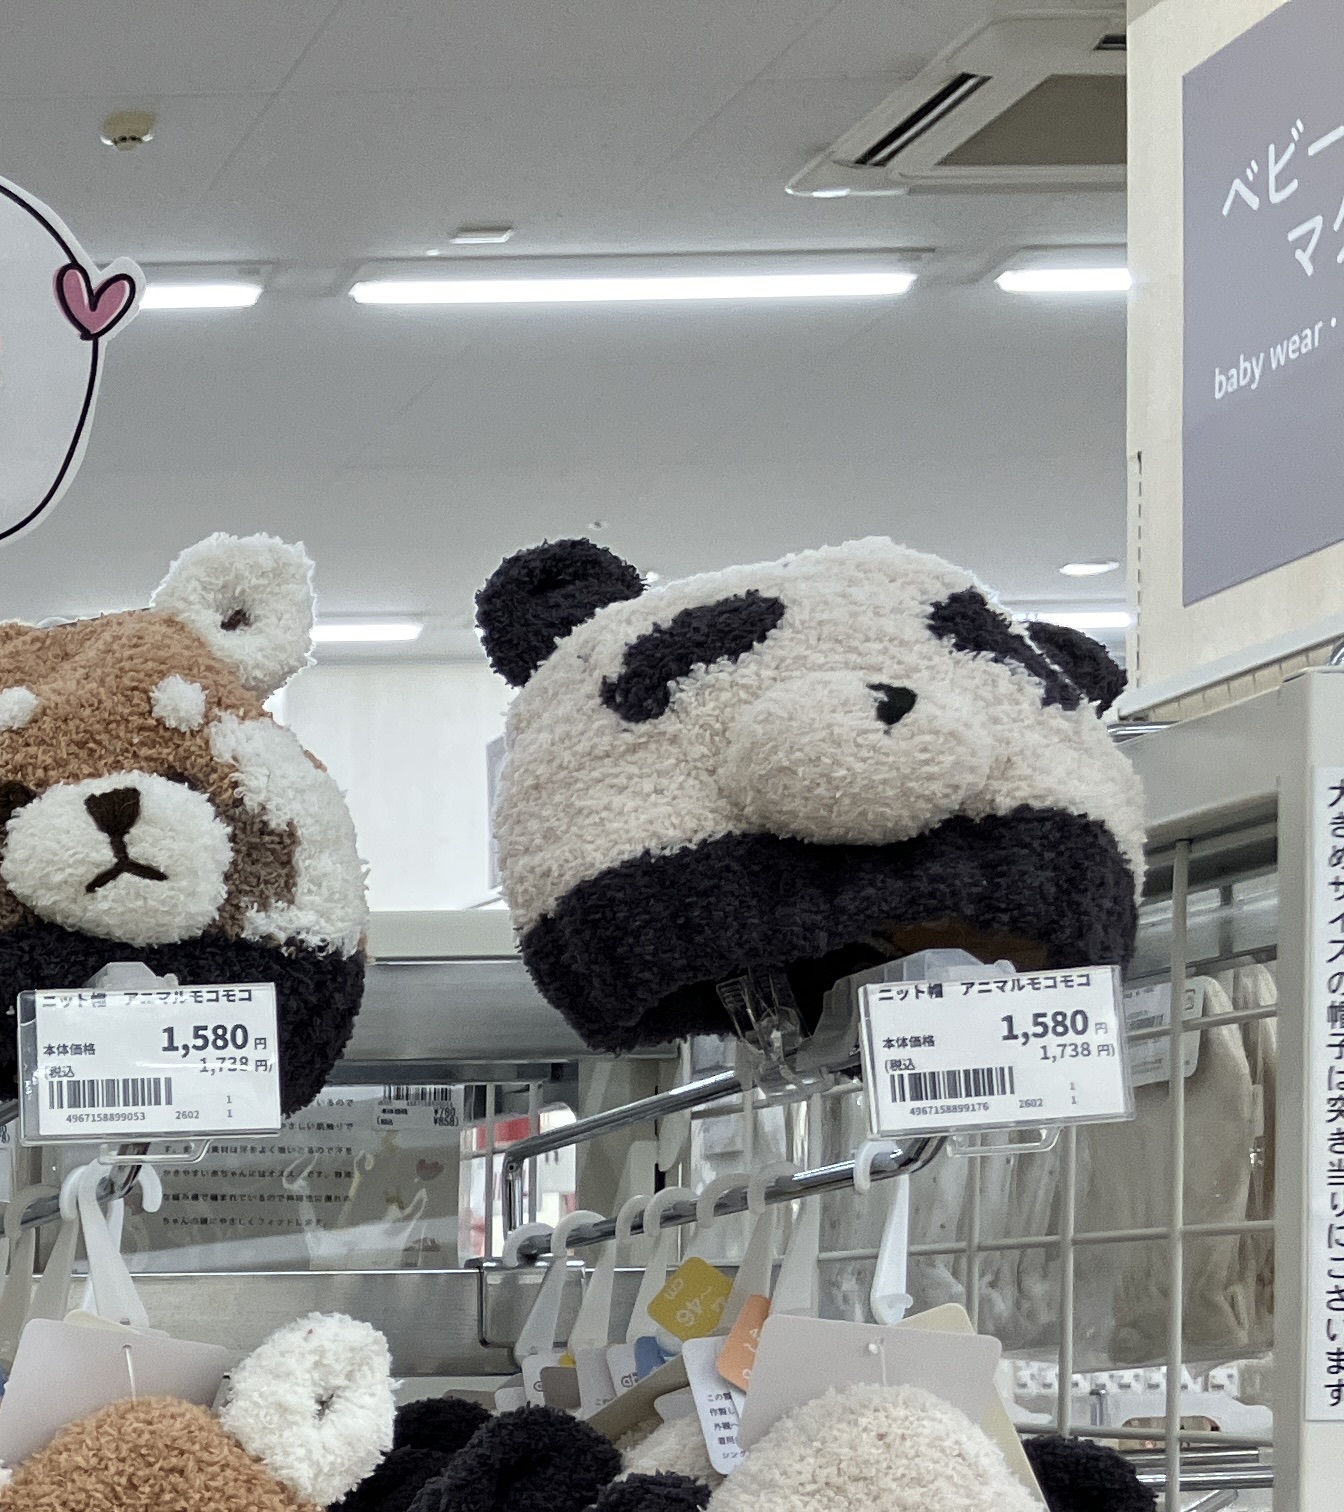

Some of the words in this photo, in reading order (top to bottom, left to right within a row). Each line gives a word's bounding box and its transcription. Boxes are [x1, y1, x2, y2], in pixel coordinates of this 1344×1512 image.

[1288, 195, 1344, 276] マ
[1215, 352, 1264, 400] baby
[1270, 320, 1323, 370] wear
[878, 984, 943, 1001] ニット帽
[961, 973, 1091, 996] アニマルモコモコ
[43, 1044, 96, 1056] 本体価格
[882, 1035, 935, 1049] 本体価格
[66, 1112, 145, 1122] 4967158899053
[176, 1111, 200, 1119] 2602
